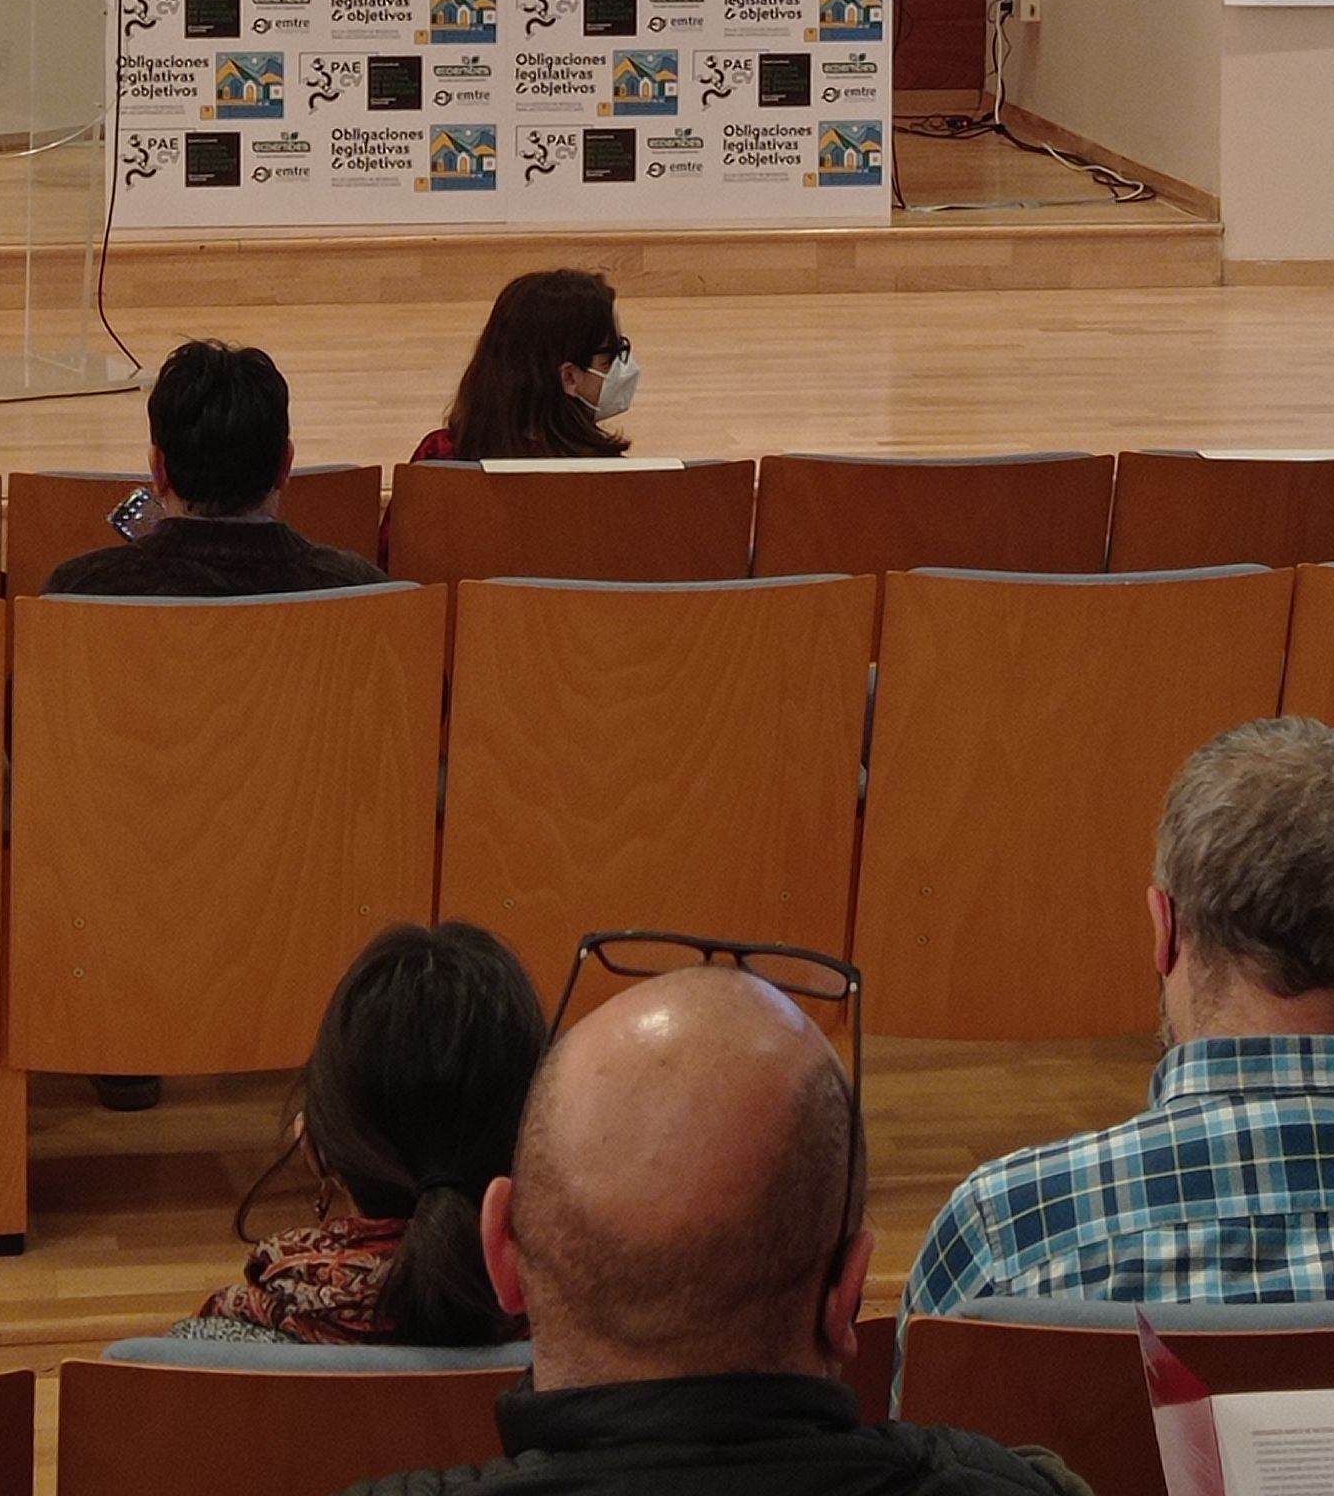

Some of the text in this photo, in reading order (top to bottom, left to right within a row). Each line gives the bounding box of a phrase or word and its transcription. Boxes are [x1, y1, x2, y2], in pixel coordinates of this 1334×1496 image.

[331, 9, 413, 24] & objetivos
[670, 16, 704, 27] emtre
[724, 7, 802, 22] & objetivos
[275, 18, 310, 28] emtre
[117, 55, 209, 70] Obligaciones
[331, 61, 361, 73] PAE
[516, 53, 607, 68] Obligaciones
[723, 59, 753, 71] PAE
[118, 69, 195, 85] gislativas
[516, 67, 593, 82] legislativas
[131, 84, 198, 99] objetivos
[456, 90, 491, 101] emtre
[516, 81, 596, 96] & objetivos
[844, 87, 877, 97] emtre
[331, 128, 424, 143] Obligaciones
[723, 124, 812, 139] Obligaciones
[147, 137, 179, 150] PAE
[547, 134, 577, 146] PAE
[723, 138, 799, 153] legislativas
[331, 141, 410, 158] legislativas
[331, 156, 413, 172] & objetivos
[669, 161, 703, 172] emtre
[723, 152, 801, 168] & objetivos
[275, 166, 310, 177] emtre
